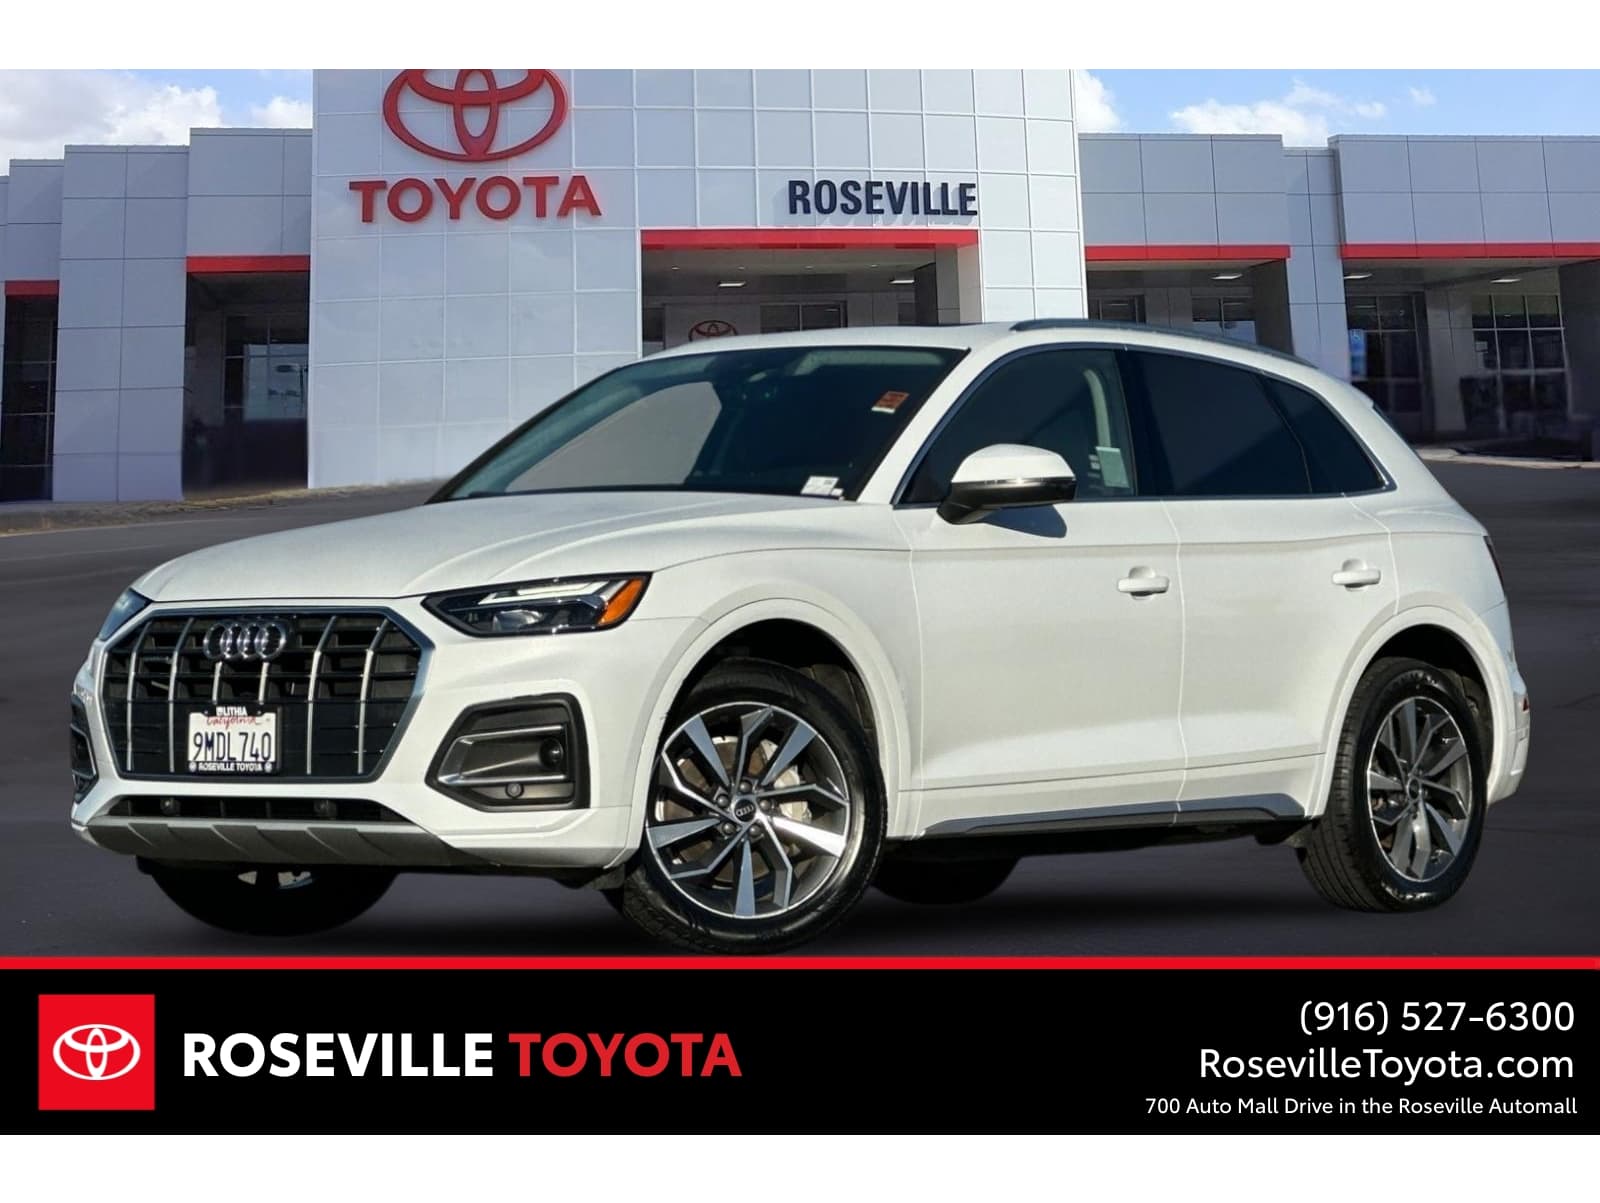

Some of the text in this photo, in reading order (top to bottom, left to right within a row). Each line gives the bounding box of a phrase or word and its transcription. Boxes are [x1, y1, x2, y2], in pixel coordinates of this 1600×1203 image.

[348, 175, 602, 223] TOYOTA
[788, 179, 978, 216] ROSEVILLE
[198, 762, 262, 771] ROSEVILLE TOYOTA
